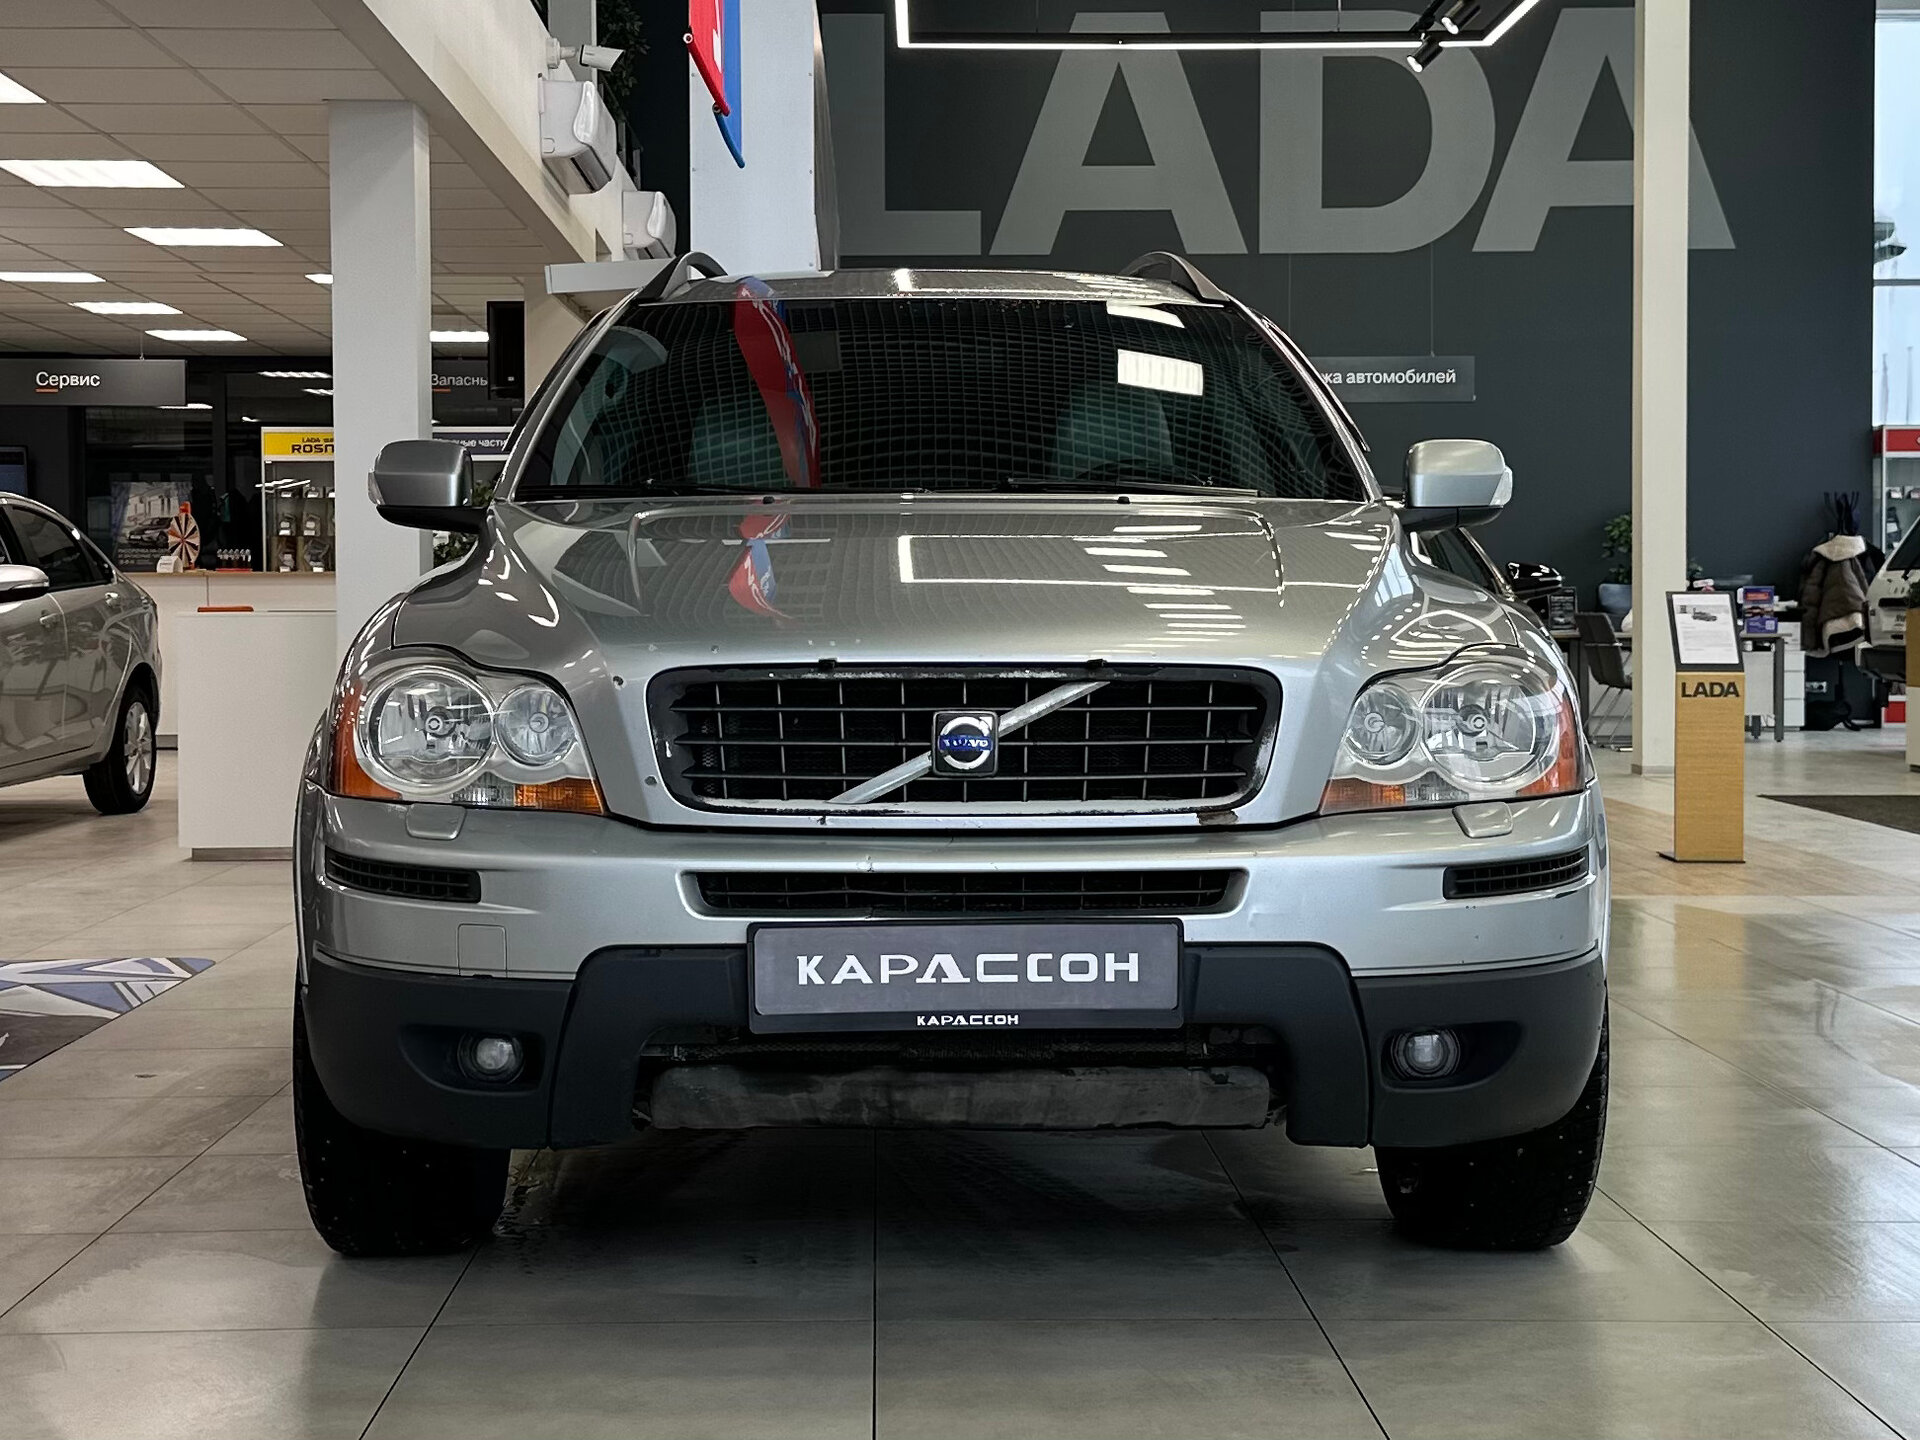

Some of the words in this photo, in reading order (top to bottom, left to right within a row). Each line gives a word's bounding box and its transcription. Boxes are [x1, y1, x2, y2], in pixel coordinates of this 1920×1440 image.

[820, 6, 1736, 256] LADA
[36, 371, 101, 389] Сервис
[1346, 369, 1456, 384] автомобилей
[1681, 682, 1740, 698] LADA
[796, 952, 1140, 986] КАРАССОН
[916, 1014, 1019, 1027] КАРАССОН
